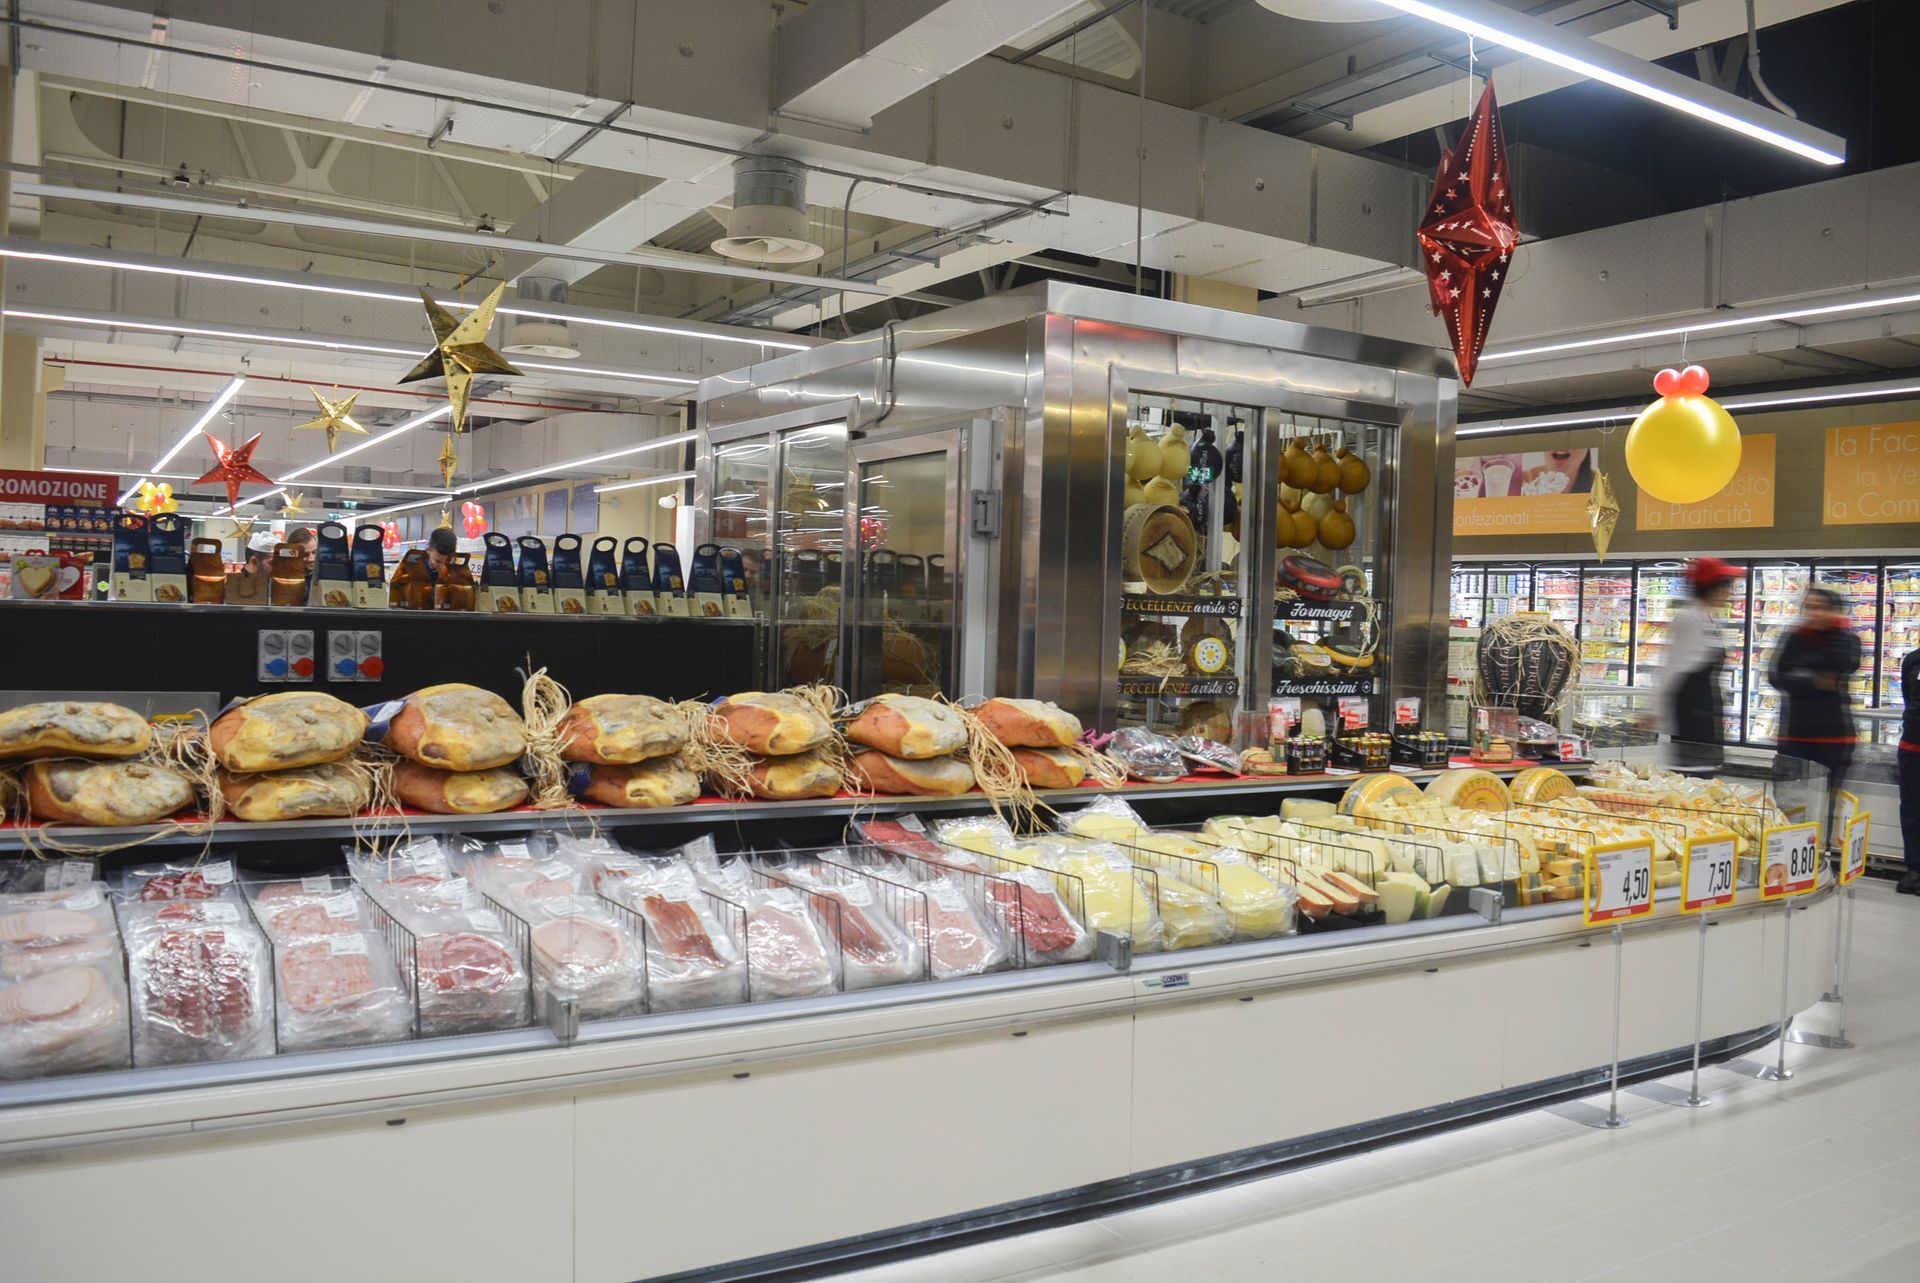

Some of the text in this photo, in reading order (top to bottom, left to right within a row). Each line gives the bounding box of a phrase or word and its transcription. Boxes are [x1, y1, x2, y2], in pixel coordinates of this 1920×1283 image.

[1835, 427, 1919, 456] la Fac
[1721, 473, 1770, 497] usto
[1856, 461, 1919, 488] la Ve
[1454, 507, 1530, 527] onfezionati
[1644, 502, 1752, 526] la Praticità
[1827, 491, 1919, 519] la Com
[1126, 599, 1194, 613] ECCELLENZE
[1202, 600, 1226, 614] vista
[1290, 602, 1354, 621] Formaggi
[1123, 682, 1192, 694] ECCELENZE
[1199, 680, 1223, 694] vista
[1276, 680, 1359, 695] Freschissimi
[1790, 845, 1816, 877] 8,80
[1622, 867, 1649, 906] 4,50
[1708, 860, 1732, 896] 7,50
